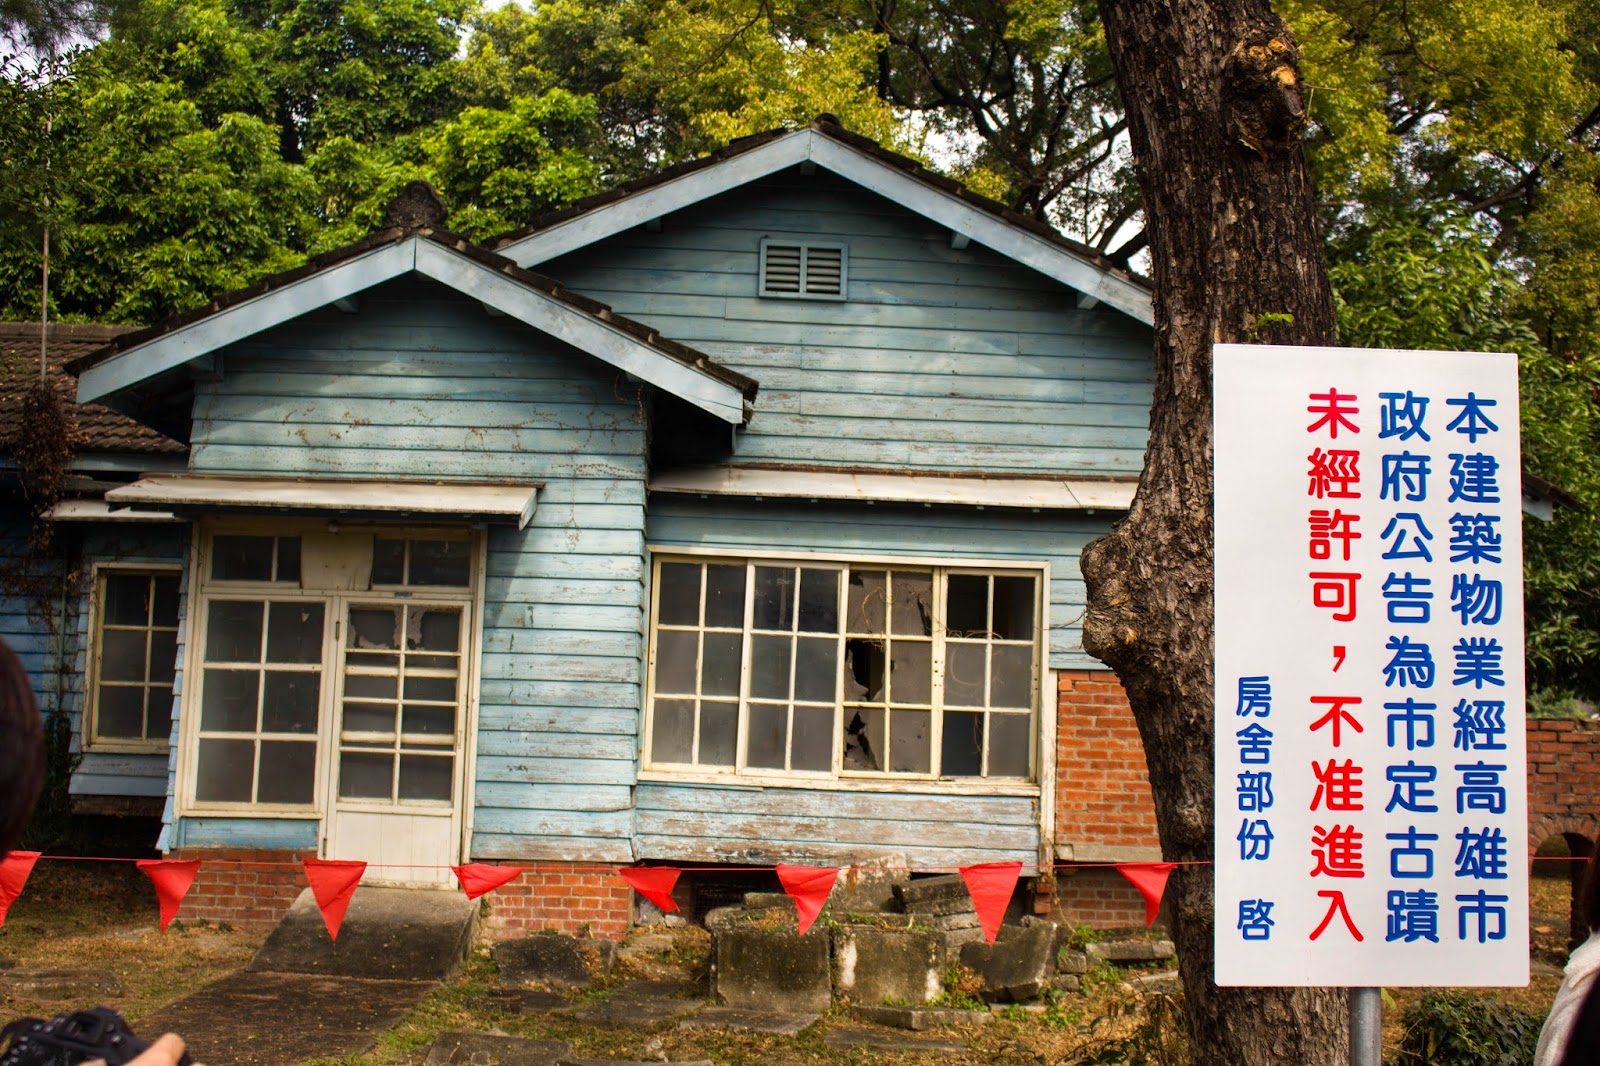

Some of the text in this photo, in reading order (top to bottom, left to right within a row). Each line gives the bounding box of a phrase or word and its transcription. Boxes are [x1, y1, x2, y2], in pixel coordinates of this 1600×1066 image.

[1236, 675, 1275, 861] 房舍部份
[1306, 386, 1365, 942] 未經許可，不准進入
[1378, 390, 1440, 943] 政府公告為市定古蹟
[1445, 392, 1508, 943] 本建築物業經高雄市
